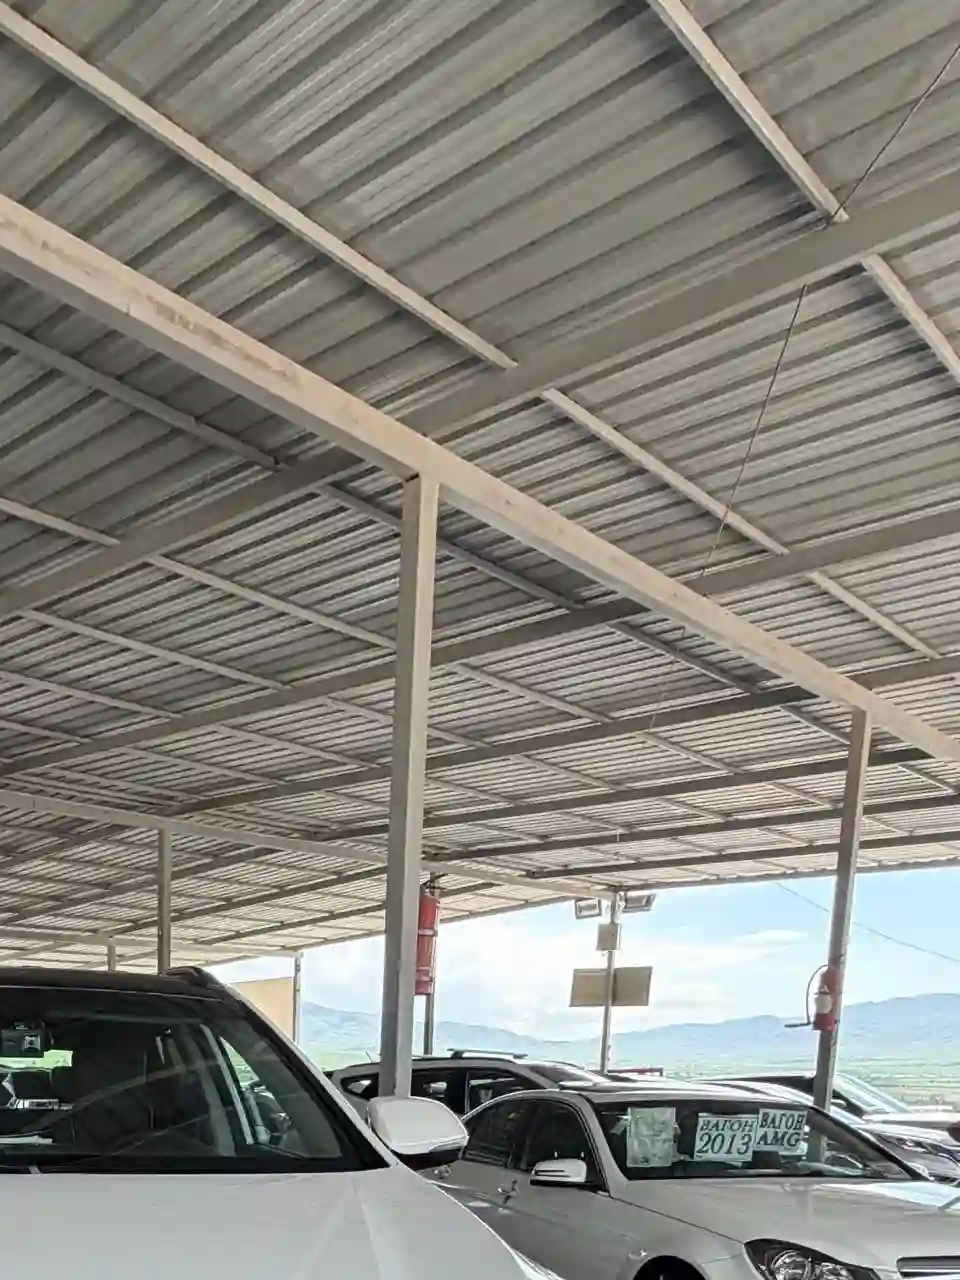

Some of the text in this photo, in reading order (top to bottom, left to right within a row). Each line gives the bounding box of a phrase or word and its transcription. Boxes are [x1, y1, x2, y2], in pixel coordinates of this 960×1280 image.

[699, 1119, 756, 1132] ВАГОН
[759, 1112, 804, 1131] ВАГОН
[696, 1132, 752, 1155] 2013
[756, 1130, 801, 1148] AMG
